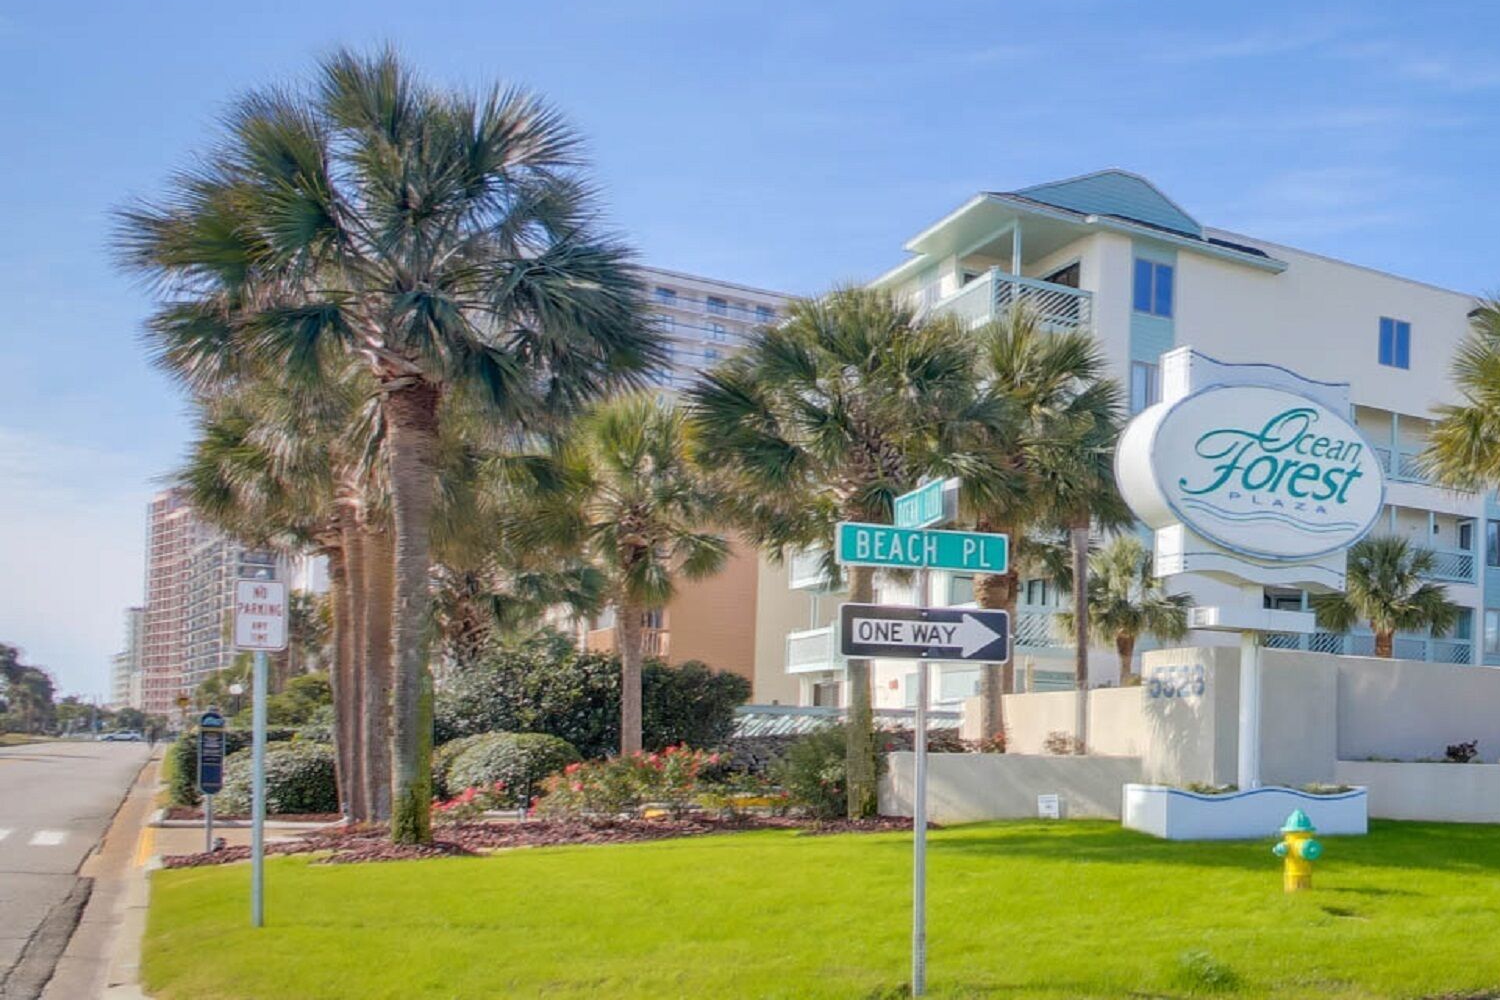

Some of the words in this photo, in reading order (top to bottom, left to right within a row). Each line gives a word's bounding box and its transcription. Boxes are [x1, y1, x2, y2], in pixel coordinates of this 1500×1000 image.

[1259, 408, 1362, 463] Ocean
[1178, 429, 1364, 503] Forest
[1229, 491, 1327, 514] PLAZA
[855, 529, 938, 564] BEACH
[962, 538, 991, 567] PL
[252, 586, 268, 599] NO
[237, 602, 282, 617] PARKING
[858, 621, 903, 642] ONE
[911, 624, 957, 644] WAY
